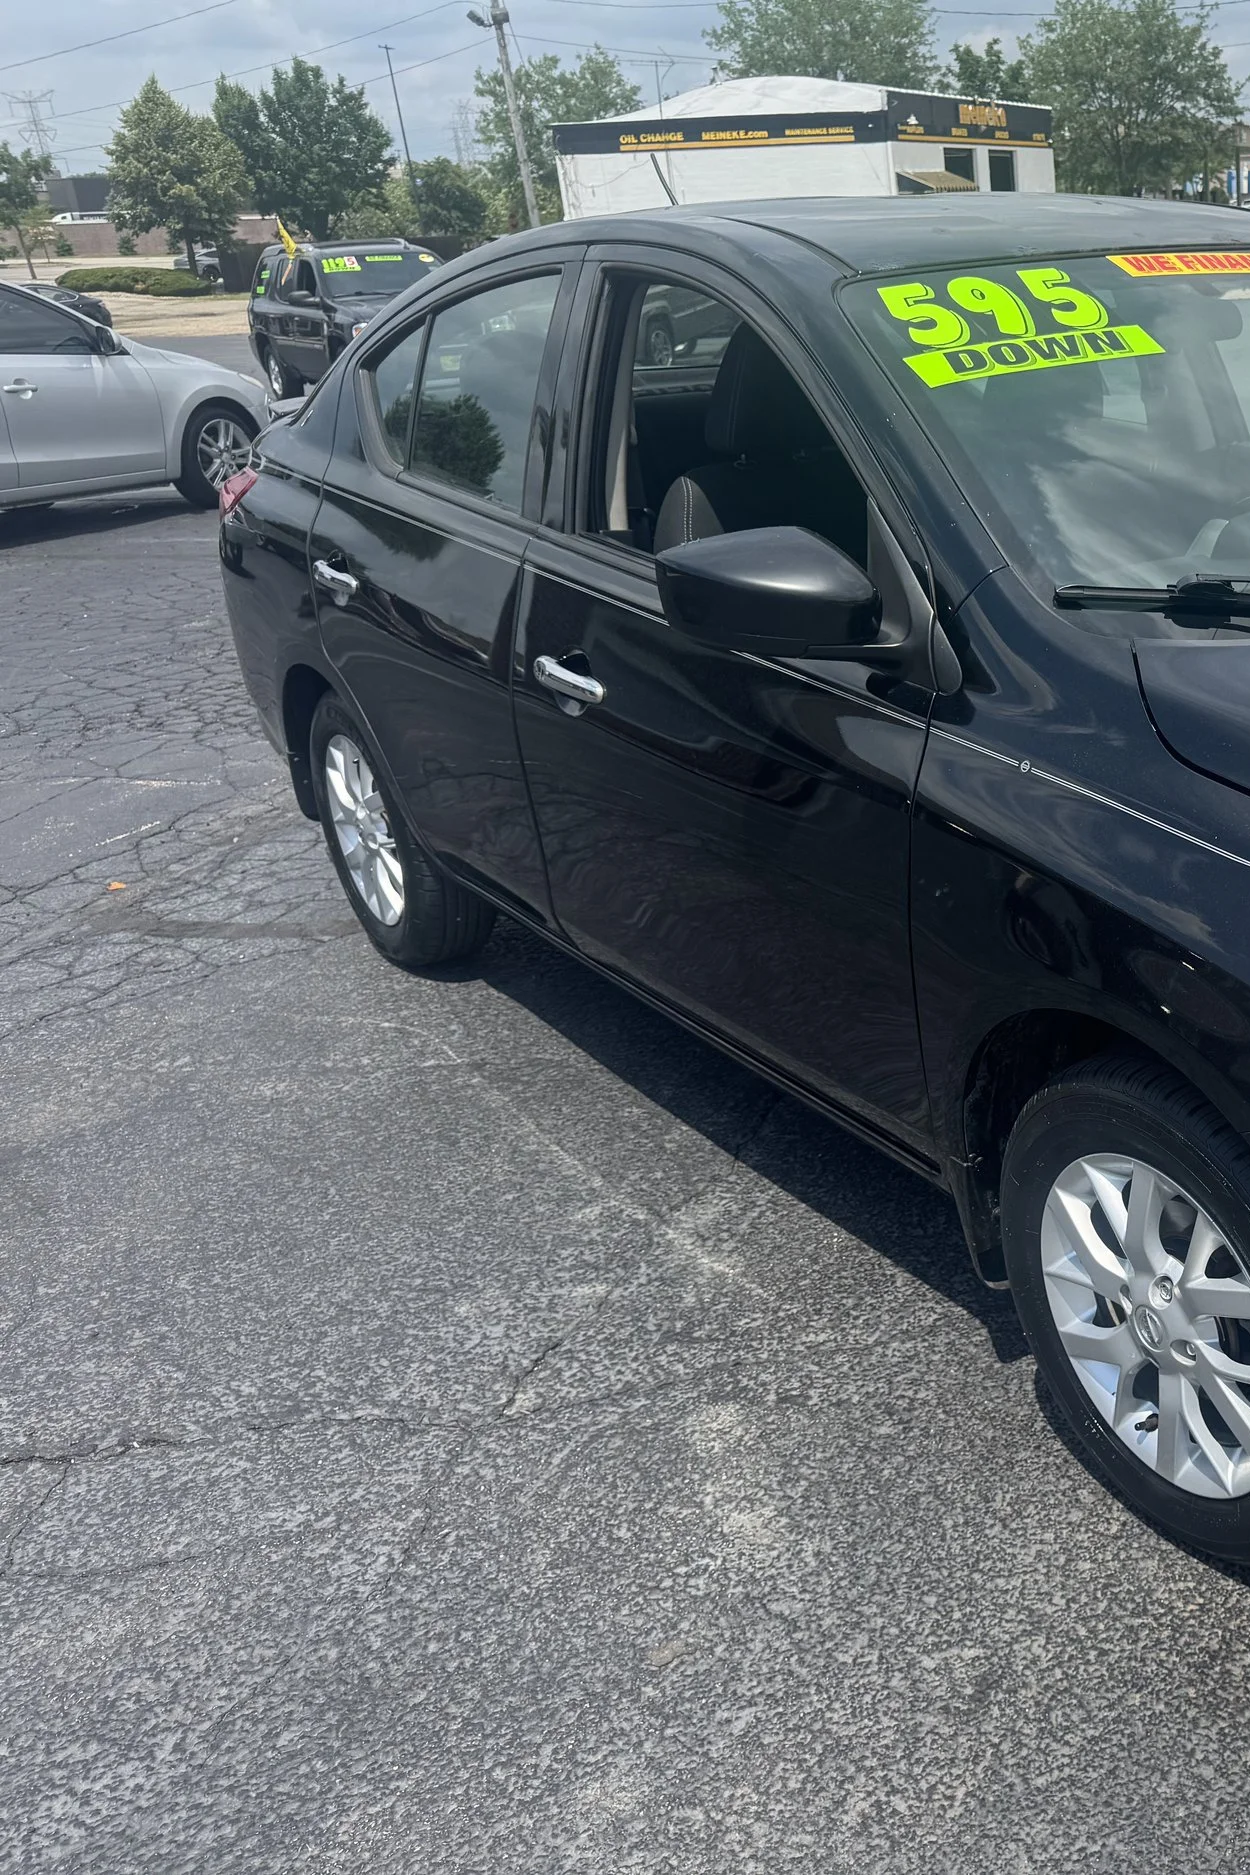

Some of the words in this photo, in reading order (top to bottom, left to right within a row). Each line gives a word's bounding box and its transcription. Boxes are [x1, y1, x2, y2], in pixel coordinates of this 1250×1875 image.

[619, 134, 638, 144] OIL
[640, 132, 684, 142] CHANGE
[701, 130, 769, 141] MEINEKE.com
[785, 128, 828, 136] MAINTENANCE
[829, 126, 854, 135] SERVICE
[1123, 255, 1180, 273] WE
[877, 267, 1109, 348] 595
[943, 330, 1134, 376] DOWN
